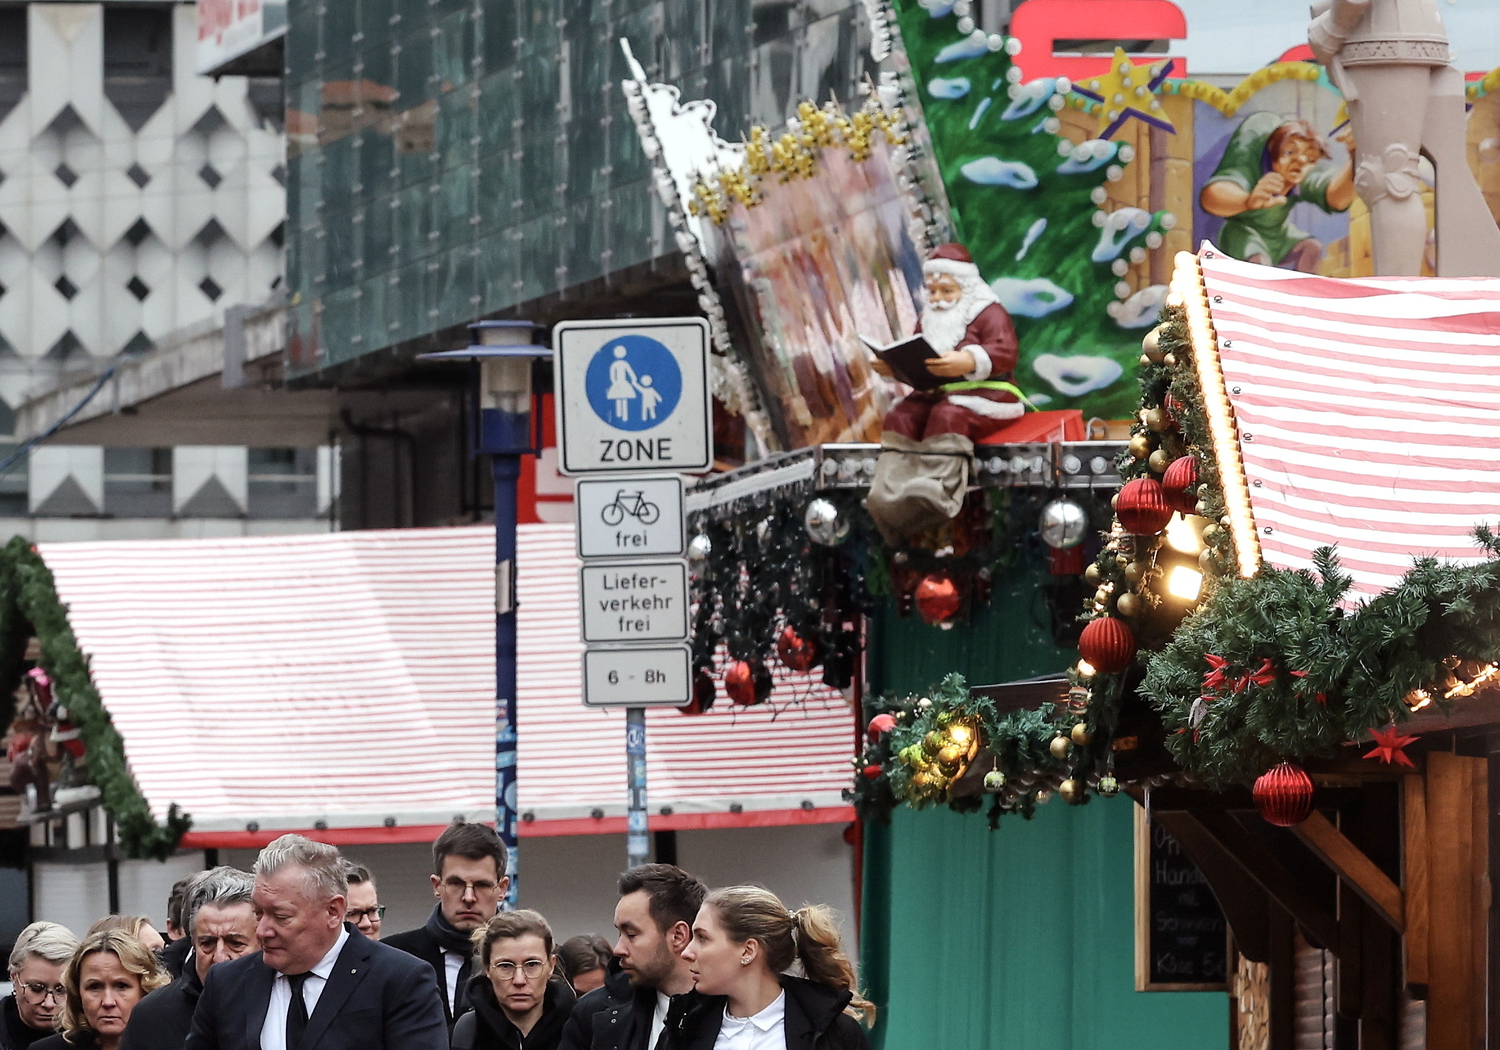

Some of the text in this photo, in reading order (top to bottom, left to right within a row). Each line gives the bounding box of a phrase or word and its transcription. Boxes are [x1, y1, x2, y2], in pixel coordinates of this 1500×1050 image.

[600, 438, 673, 462] ZONE
[616, 530, 648, 547] frei
[603, 573, 668, 591] Liefer-
[599, 594, 674, 612] verkehr
[618, 615, 650, 632] frei
[607, 669, 619, 685] 6
[645, 668, 667, 684] 8h
